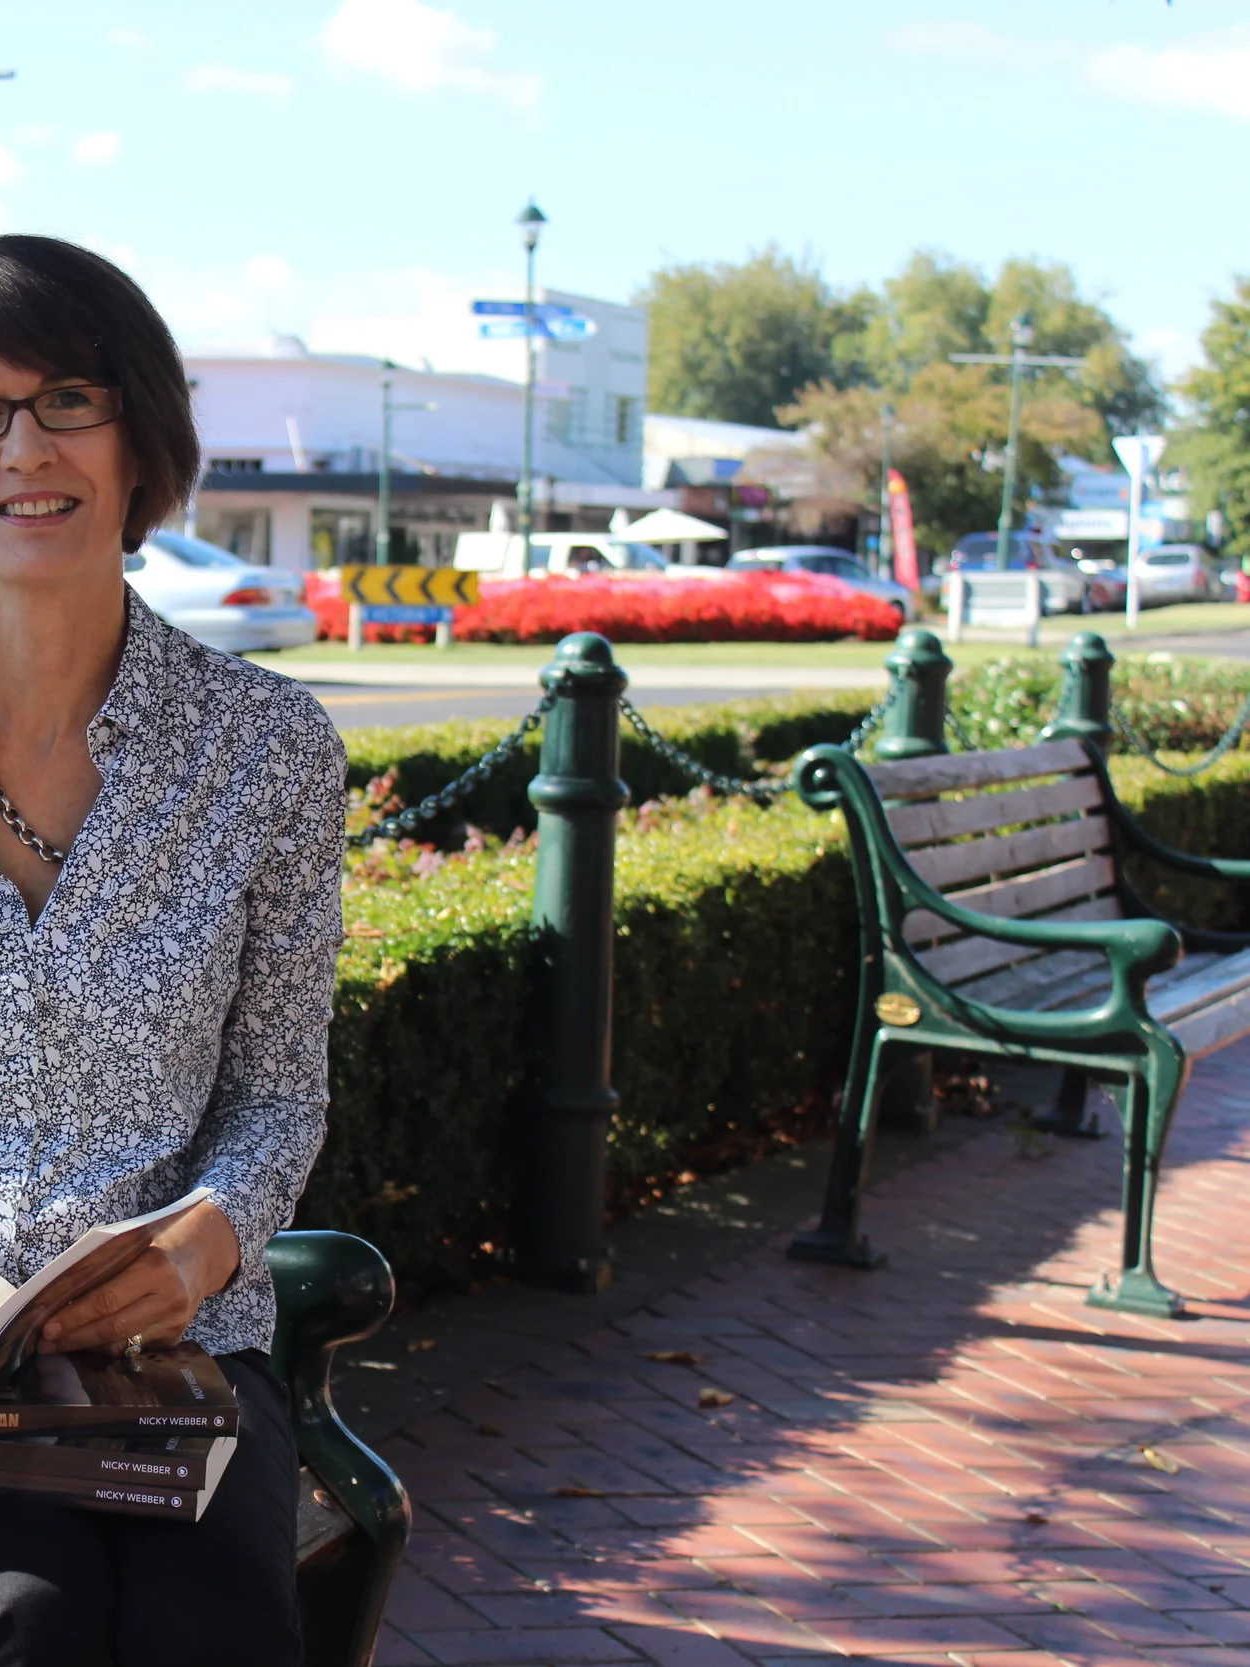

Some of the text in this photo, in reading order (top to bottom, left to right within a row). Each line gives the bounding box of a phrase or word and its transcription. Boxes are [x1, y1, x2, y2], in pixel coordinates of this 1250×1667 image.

[138, 1416, 208, 1426] NICKY WEBBER
[101, 1460, 171, 1475] NICKY WEBBER
[95, 1489, 165, 1505] NICKY WEBBER
